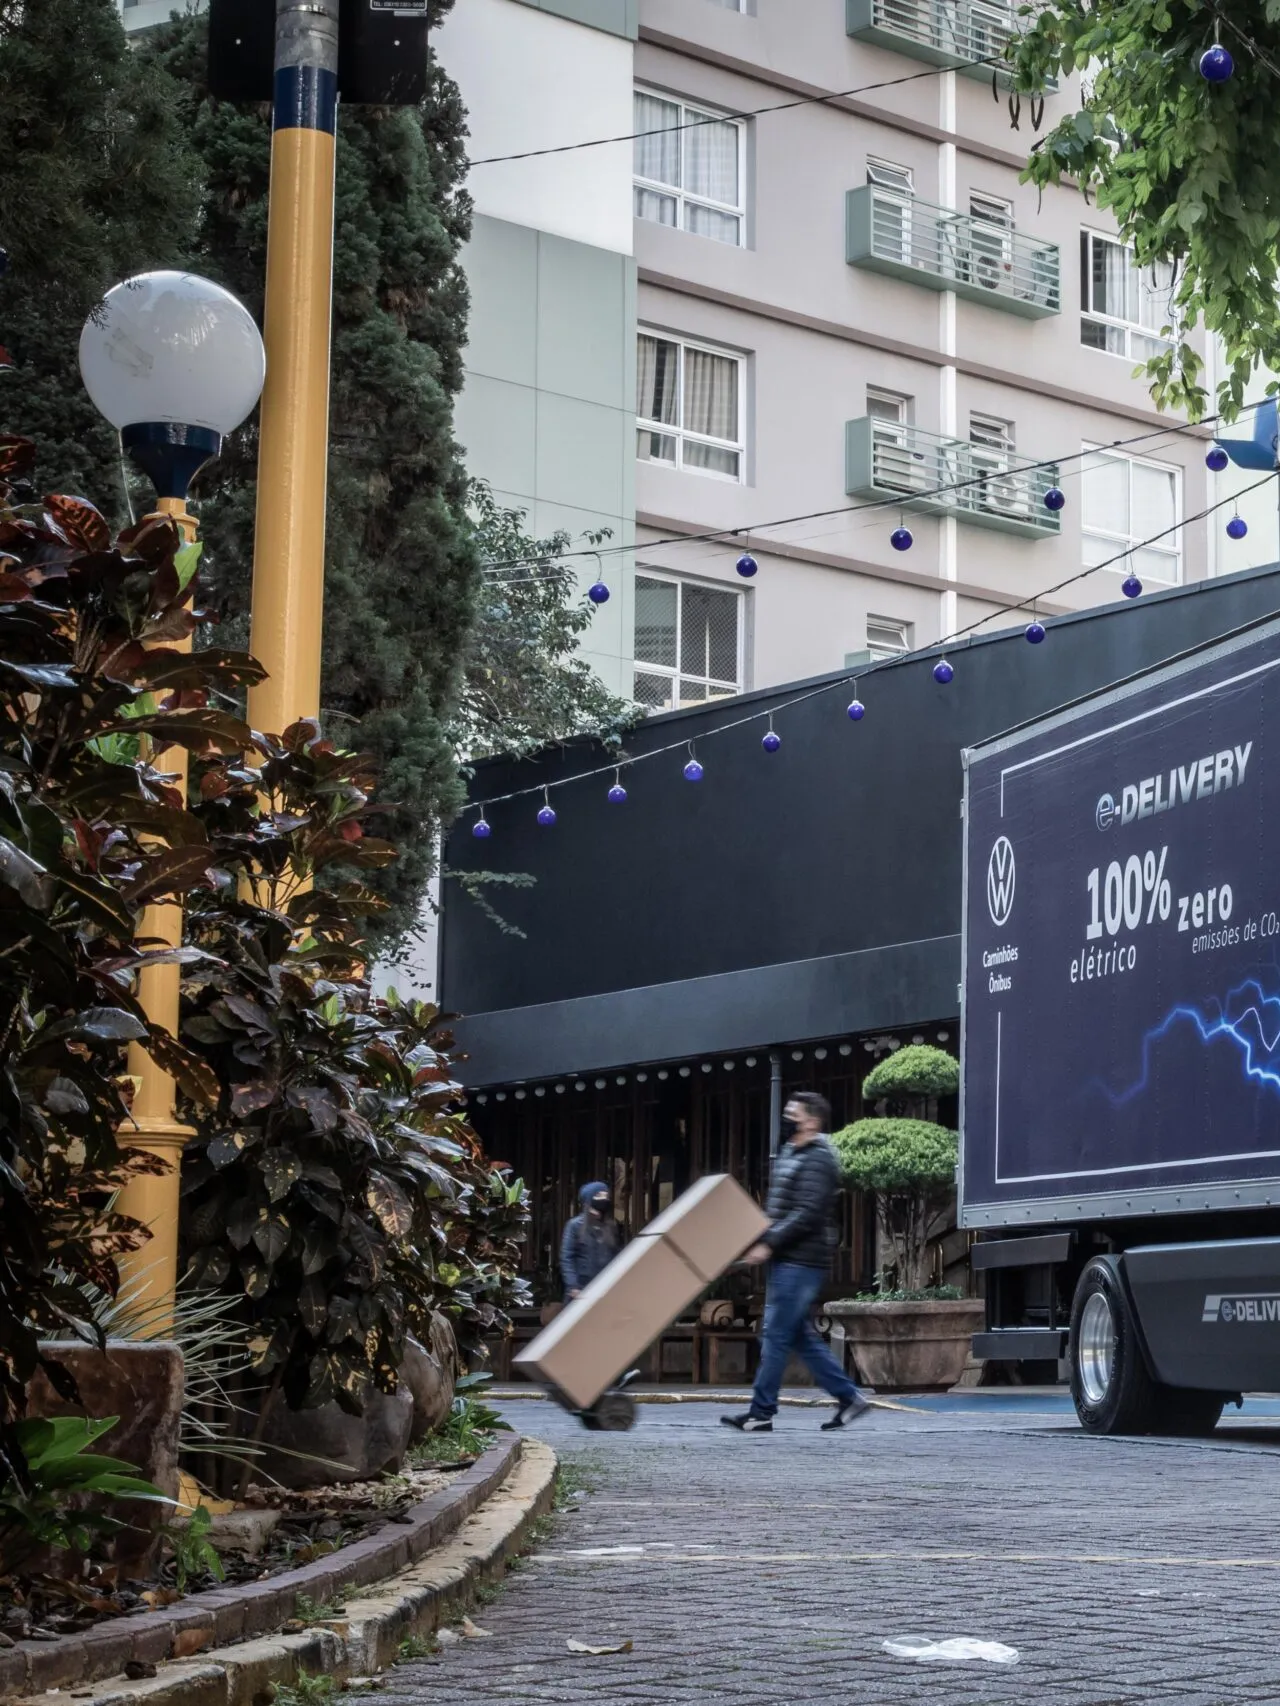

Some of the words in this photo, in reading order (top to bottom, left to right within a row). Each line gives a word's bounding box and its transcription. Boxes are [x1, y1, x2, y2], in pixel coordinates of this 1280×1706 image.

[1095, 741, 1253, 832] e-DELIVERY
[1086, 845, 1172, 940] 100%
[1178, 883, 1233, 932] zero
[982, 944, 1019, 968] Caminhões
[1192, 925, 1240, 954] emissões
[1243, 917, 1257, 941] de
[988, 971, 1012, 994] Ônibus
[1070, 941, 1137, 983] elétrico
